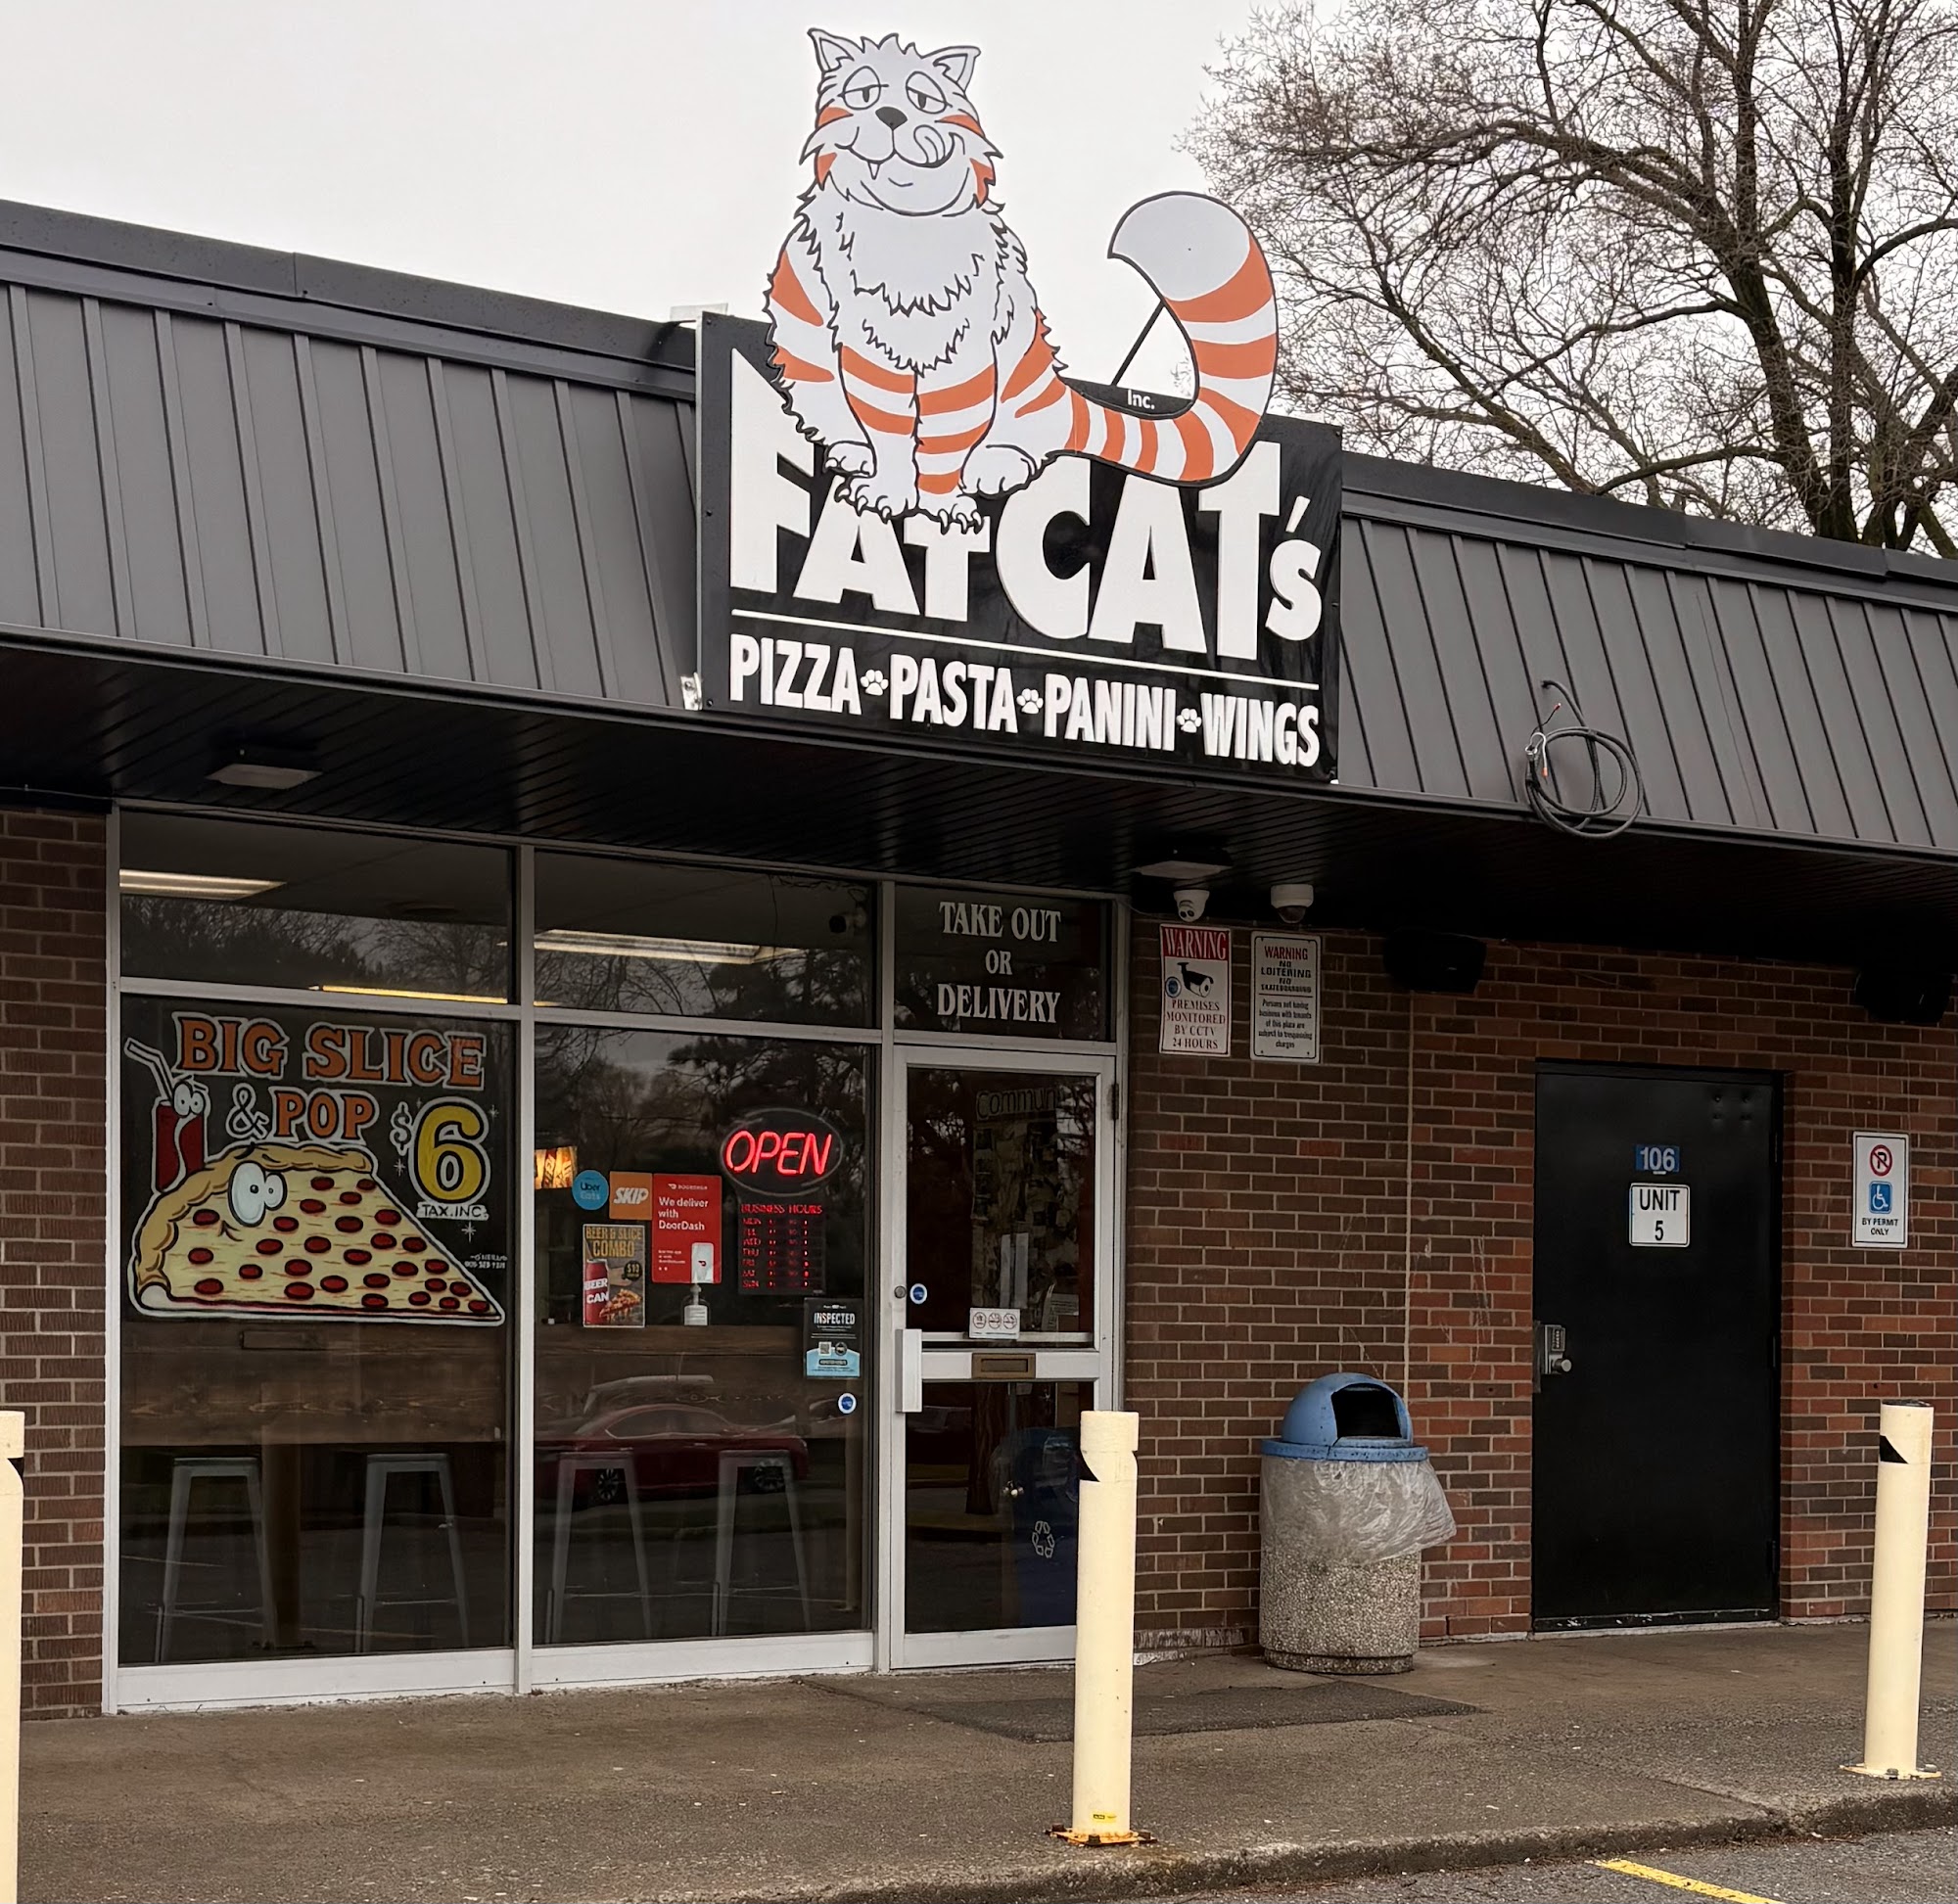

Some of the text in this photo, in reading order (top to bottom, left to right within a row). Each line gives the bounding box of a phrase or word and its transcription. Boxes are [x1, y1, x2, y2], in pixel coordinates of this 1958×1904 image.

[1127, 390, 1155, 410] Inc.
[730, 348, 990, 622] FAT
[730, 633, 1321, 767] PIZZA PASTA PANINI WINGS
[939, 901, 1061, 943] TAKE OUT
[1164, 928, 1227, 960] WARNING
[1264, 946, 1309, 960] WARNING
[985, 949, 1012, 977] OR
[1261, 967, 1312, 979] LOITERING
[937, 983, 1061, 1024] DELIVERY
[1171, 998, 1220, 1011] PREMISES
[1166, 1011, 1226, 1025] MONITORED
[1175, 1025, 1215, 1037] BY CCTV
[174, 1014, 486, 1089] BIG SLICE
[1173, 1038, 1219, 1049] 24 HOURS
[227, 1084, 379, 1141] & POP
[725, 1130, 832, 1175] OPEN
[1640, 1146, 1676, 1172] 106
[581, 1182, 600, 1191] Uber
[613, 1186, 649, 1205] SKIP
[658, 1196, 709, 1208] We deliver
[1640, 1188, 1680, 1211] UNIT
[658, 1208, 679, 1219] with
[788, 1204, 822, 1214] HOURS
[658, 1219, 705, 1231] DoorDash
[1655, 1220, 1664, 1241] 5
[1873, 1218, 1898, 1227] PERMIT
[585, 1227, 607, 1239] BEER
[618, 1228, 642, 1240] SLICE
[592, 1240, 634, 1258] COMBO
[586, 1292, 609, 1304] CAN
[814, 1312, 856, 1324] INSPECTED
